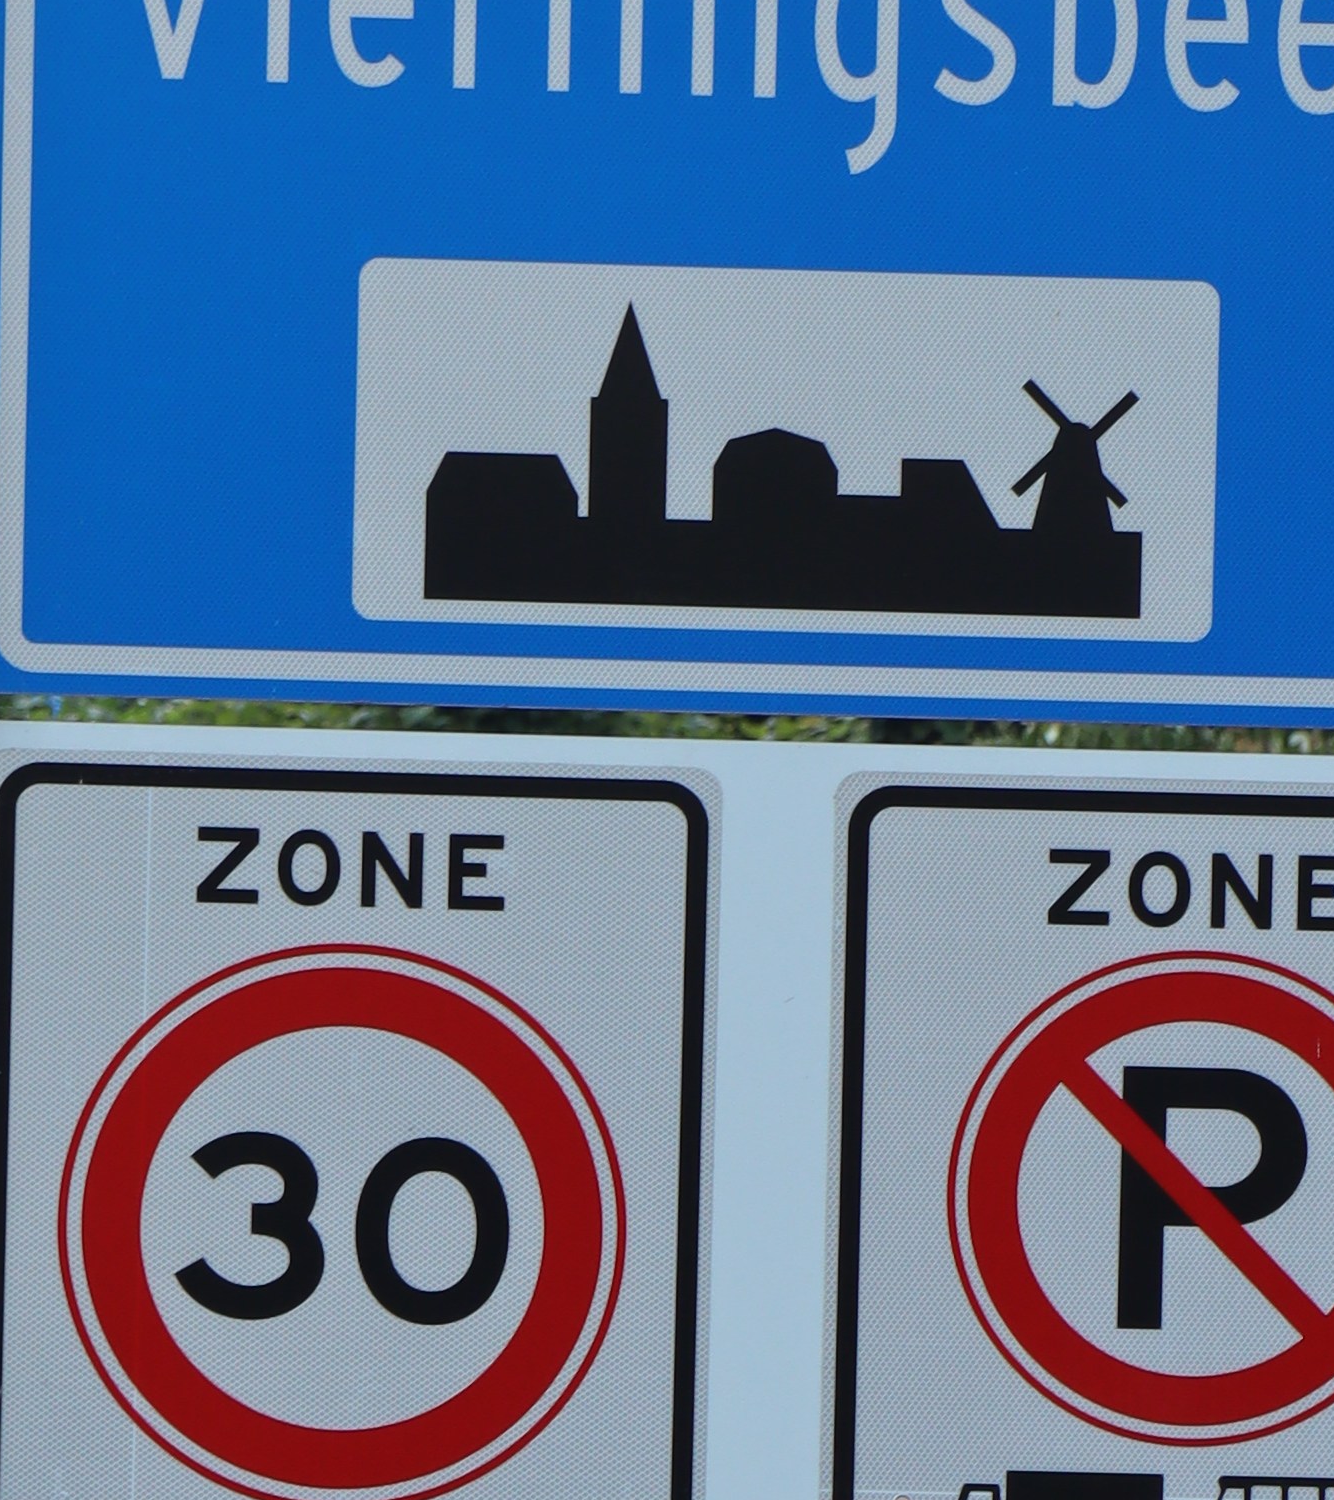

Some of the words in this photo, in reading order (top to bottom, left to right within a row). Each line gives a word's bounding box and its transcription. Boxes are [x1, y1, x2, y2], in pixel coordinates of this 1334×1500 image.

[196, 826, 505, 912] ZONE
[174, 1131, 510, 1326] 30
[1117, 1065, 1308, 1330] P
